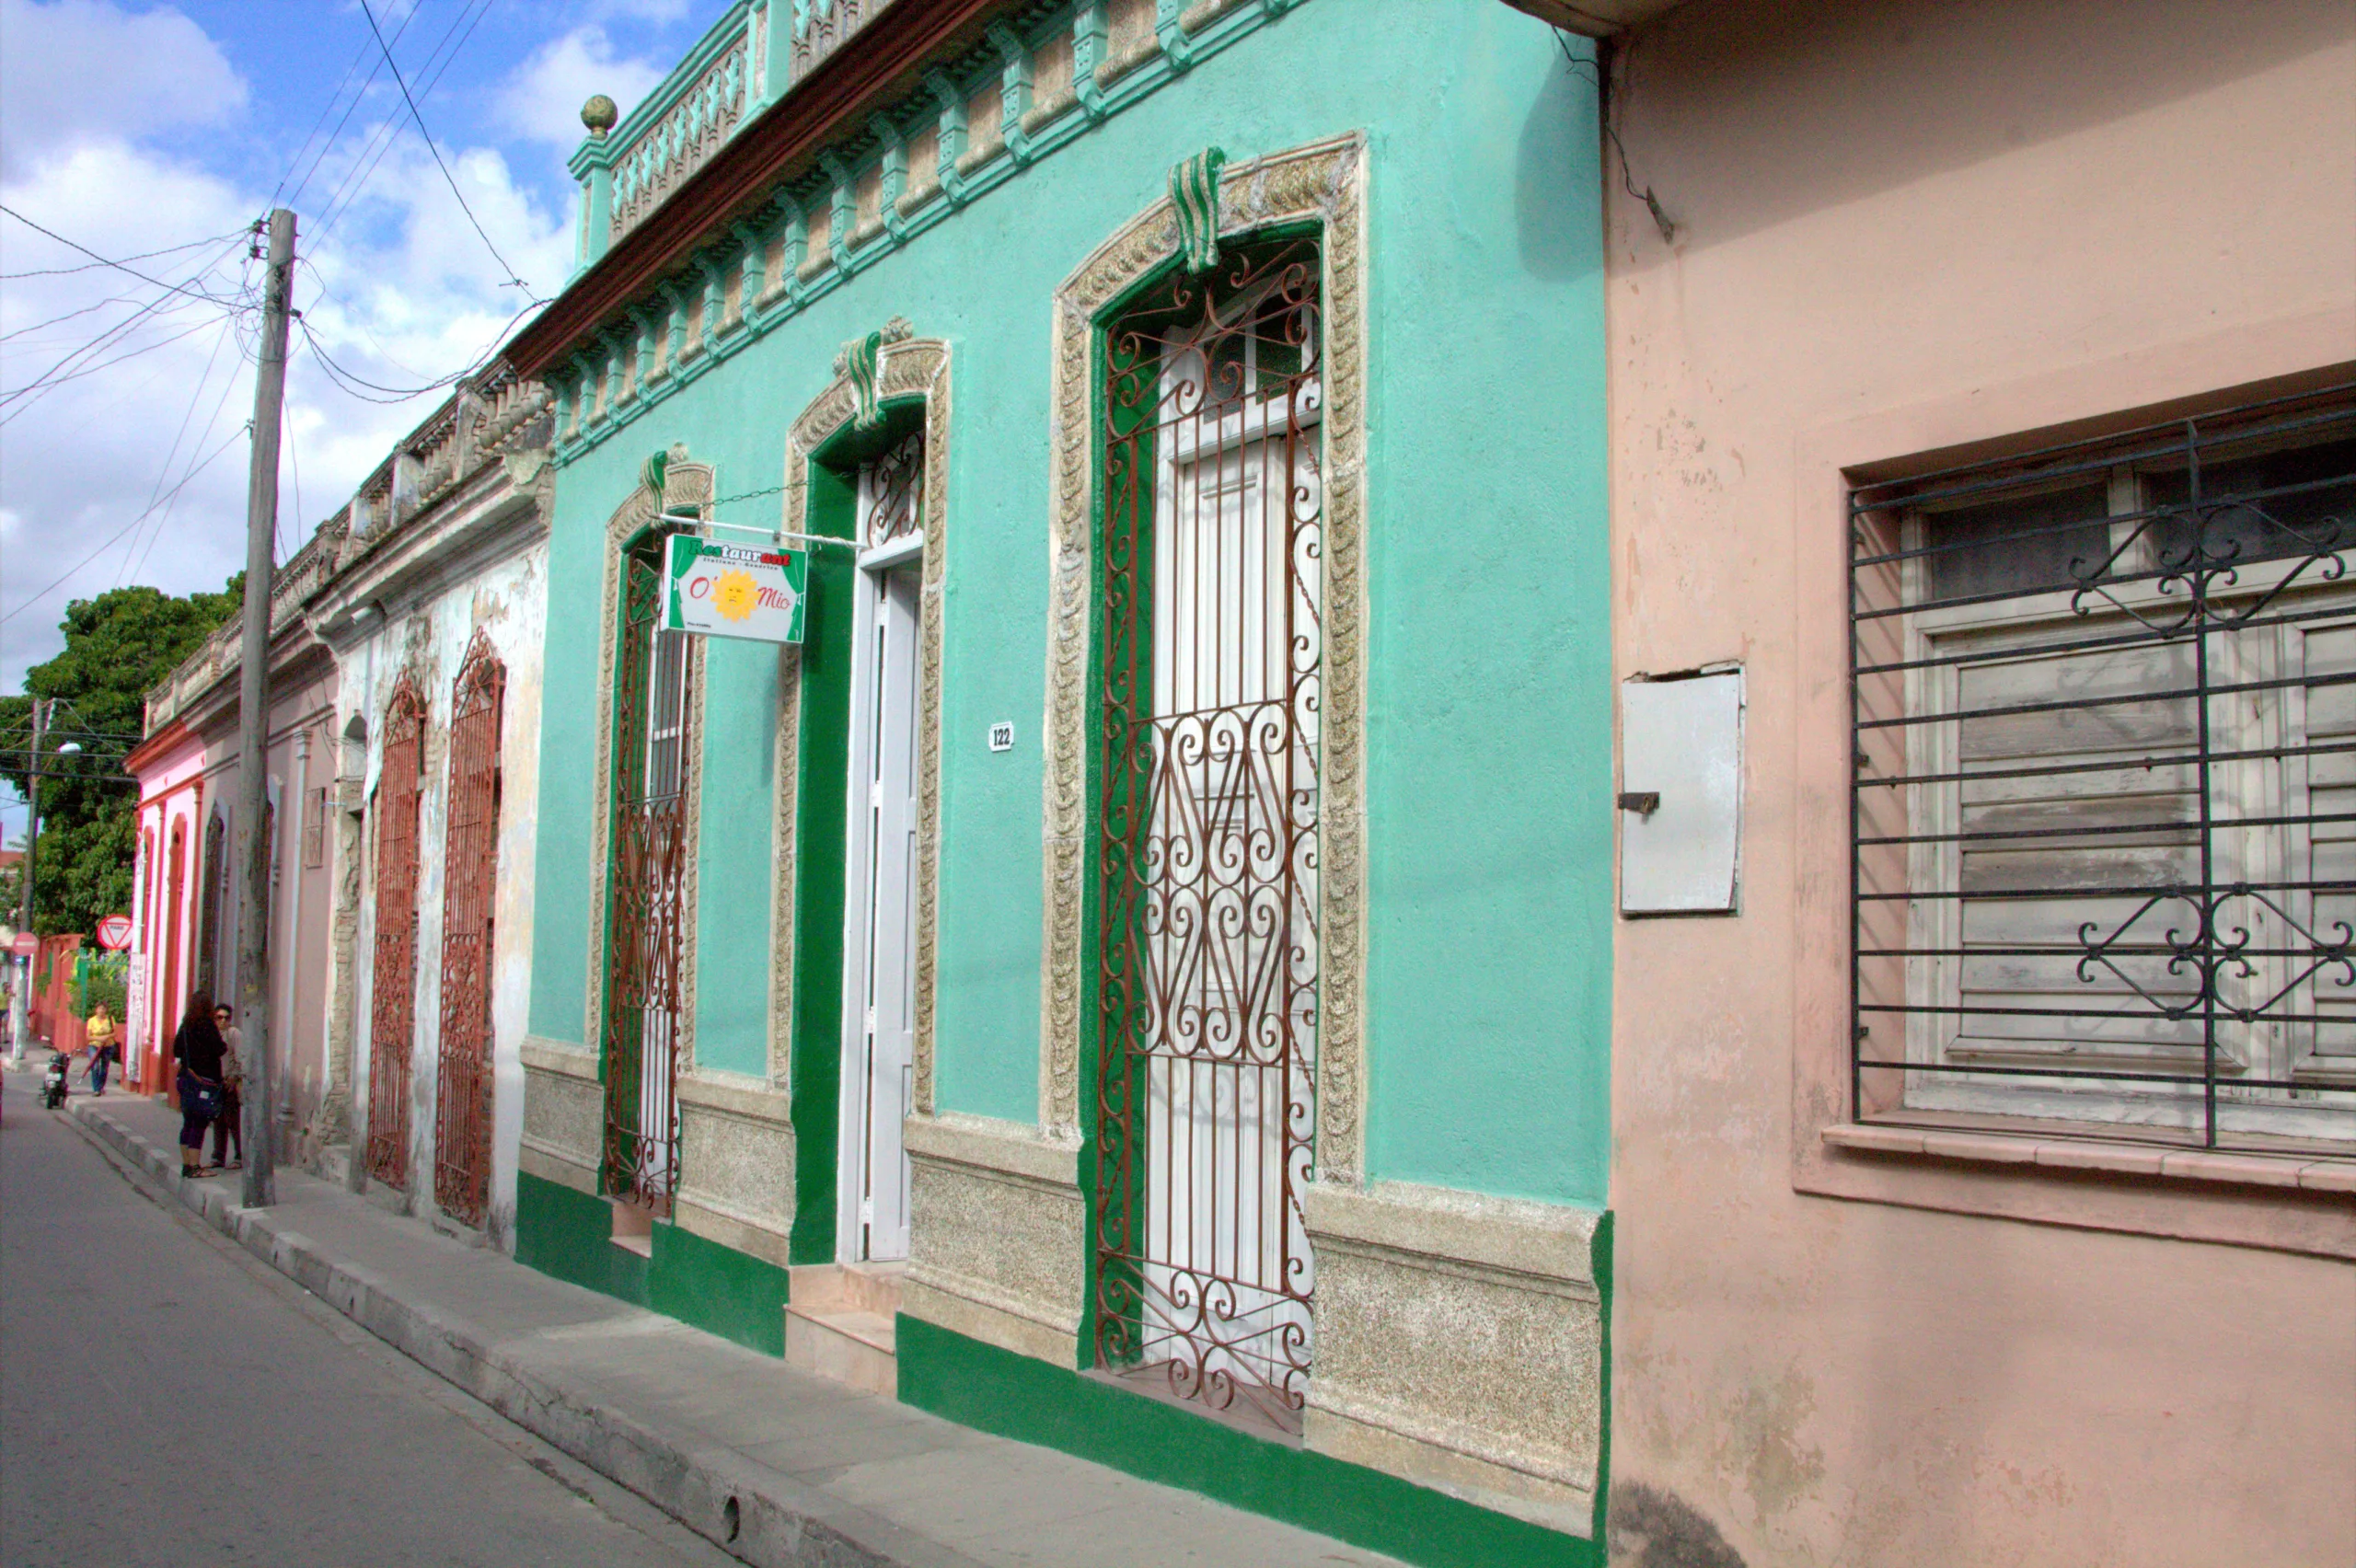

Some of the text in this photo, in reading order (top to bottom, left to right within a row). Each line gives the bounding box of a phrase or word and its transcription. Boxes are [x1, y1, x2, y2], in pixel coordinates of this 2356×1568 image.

[688, 540, 791, 566] Restaurant
[757, 586, 791, 609] Mio
[994, 728, 1011, 745] 122
